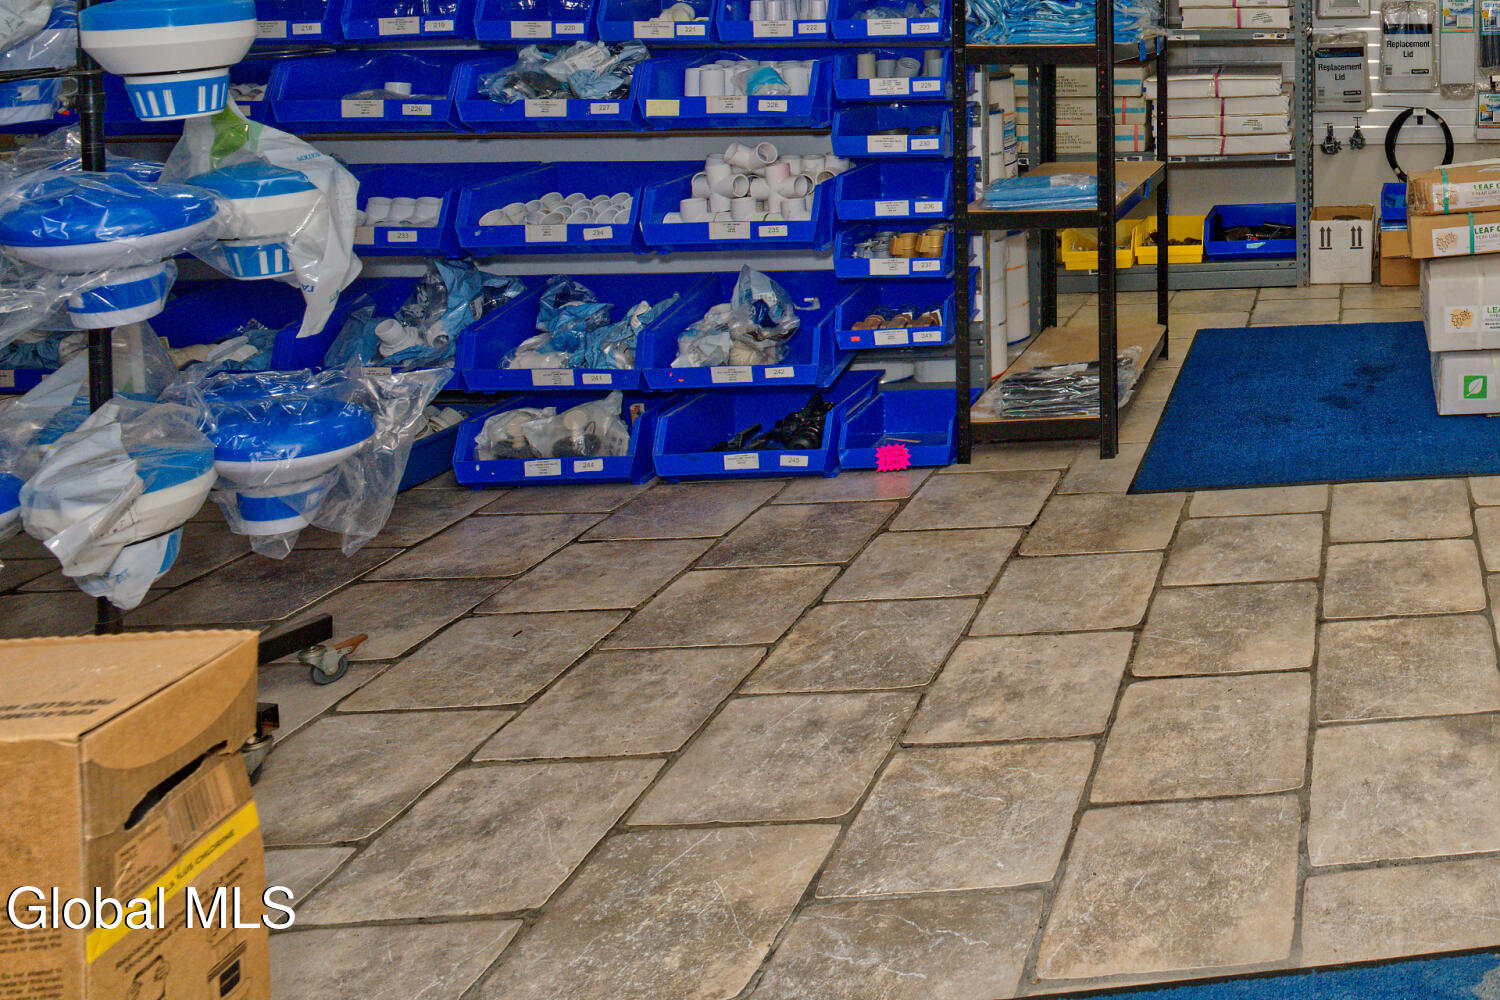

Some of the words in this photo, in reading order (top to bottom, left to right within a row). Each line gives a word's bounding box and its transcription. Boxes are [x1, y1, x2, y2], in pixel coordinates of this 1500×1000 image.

[1387, 40, 1430, 48] Replacement
[1403, 50, 1414, 58] Lid
[1318, 63, 1362, 72] Replacement
[592, 228, 604, 236] 234
[1474, 226, 1494, 234] LEAF
[772, 368, 786, 376] 242
